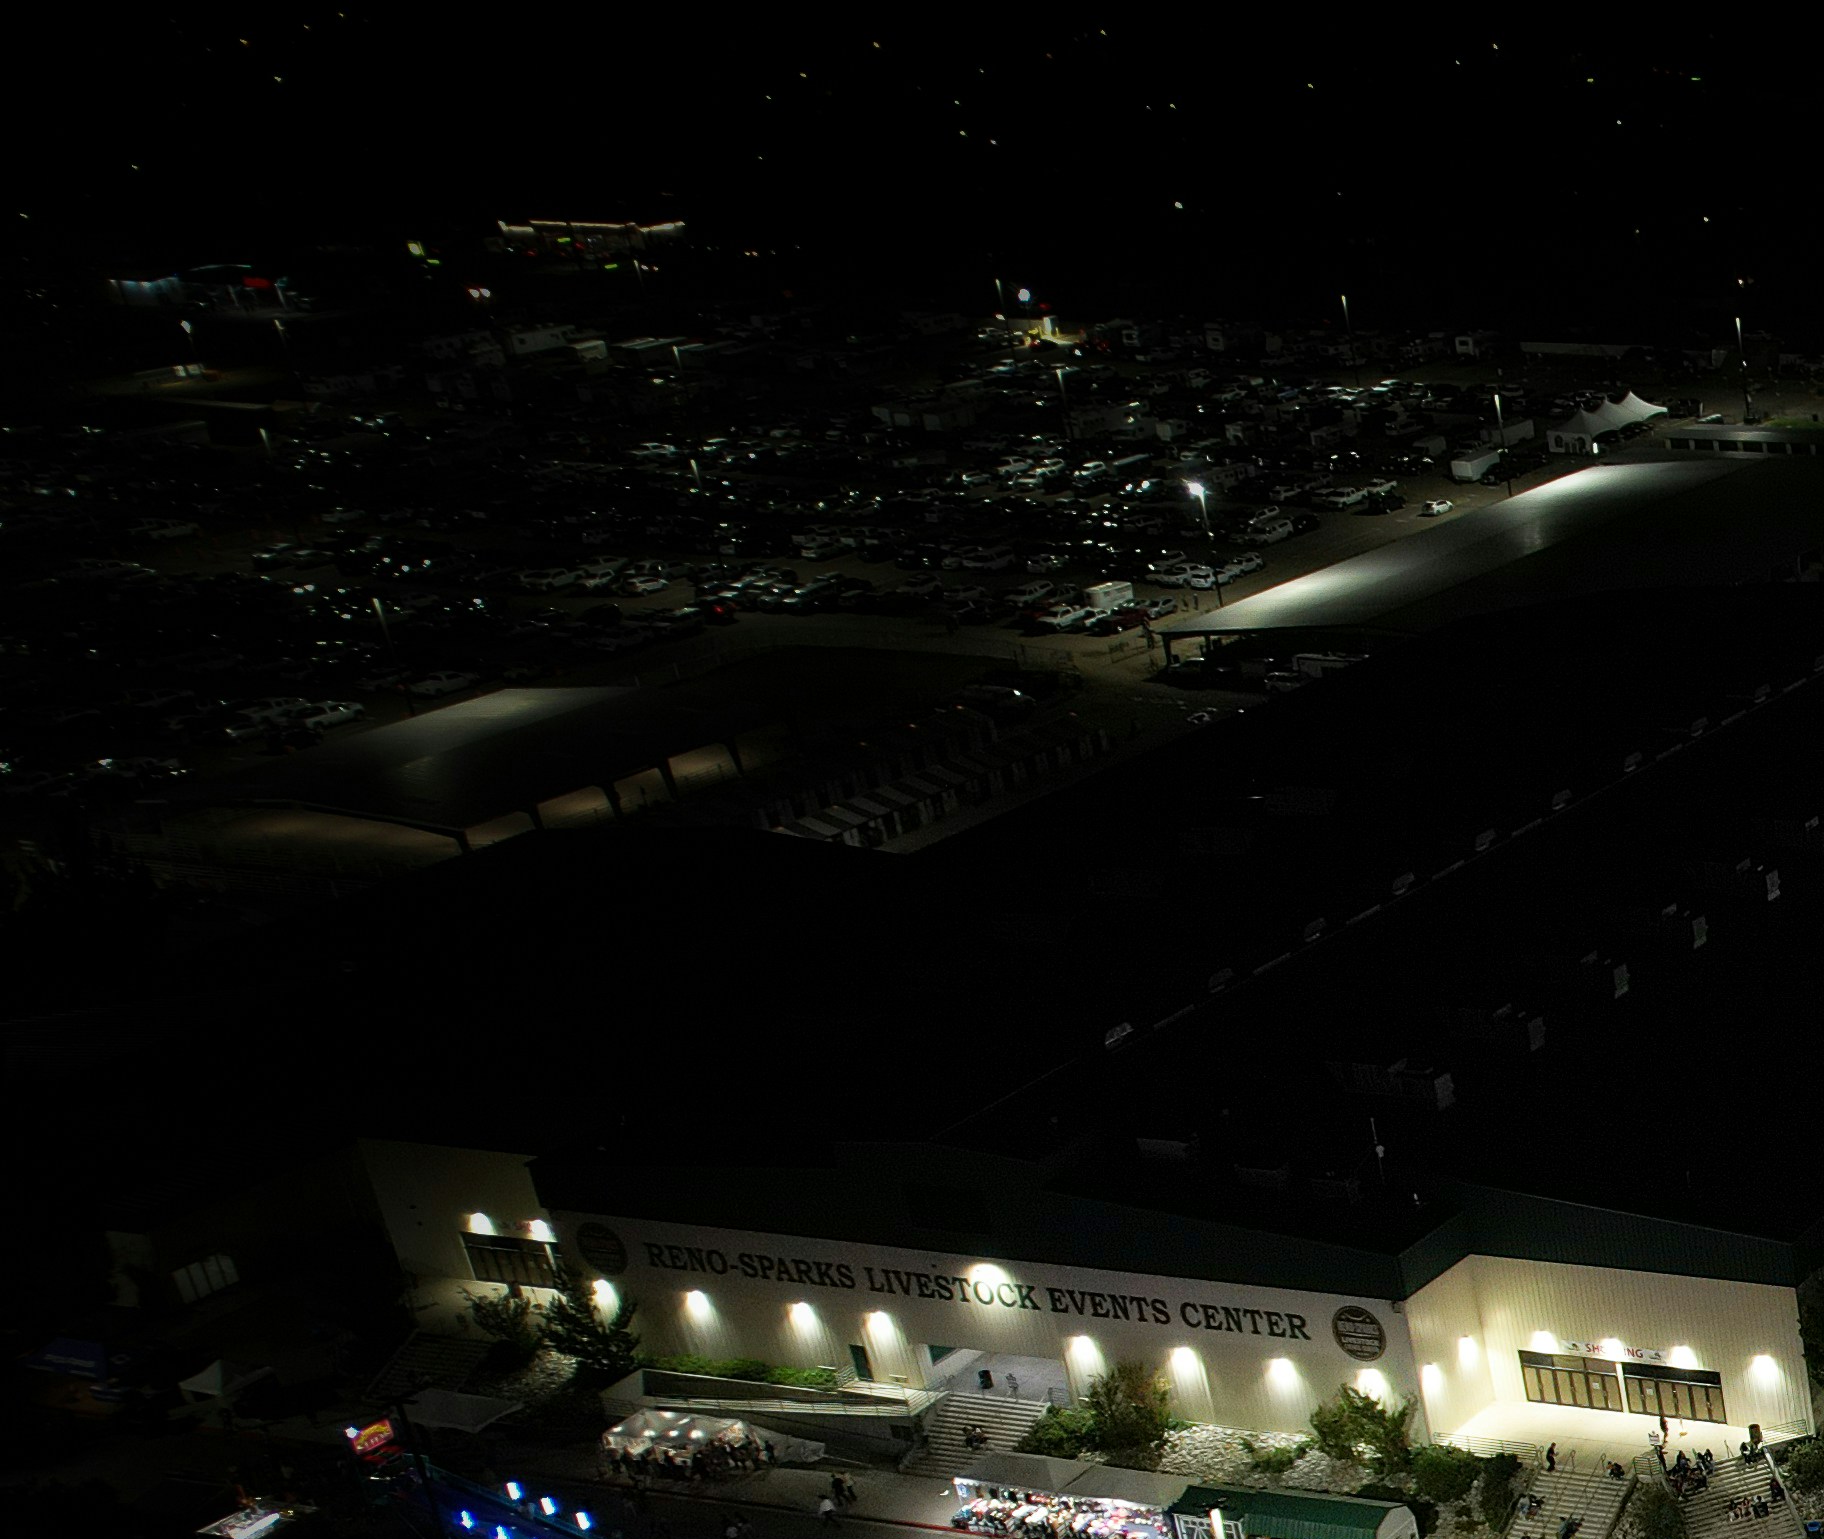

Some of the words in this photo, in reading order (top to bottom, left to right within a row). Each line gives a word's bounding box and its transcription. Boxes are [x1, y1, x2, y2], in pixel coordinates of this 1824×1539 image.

[643, 1242, 856, 1289] RENO-SPARKS
[864, 1266, 1041, 1311] LIVESTOCK
[1045, 1286, 1171, 1325] EVENTS
[1179, 1302, 1312, 1341] CENTER
[1586, 1343, 1644, 1359] SHING
